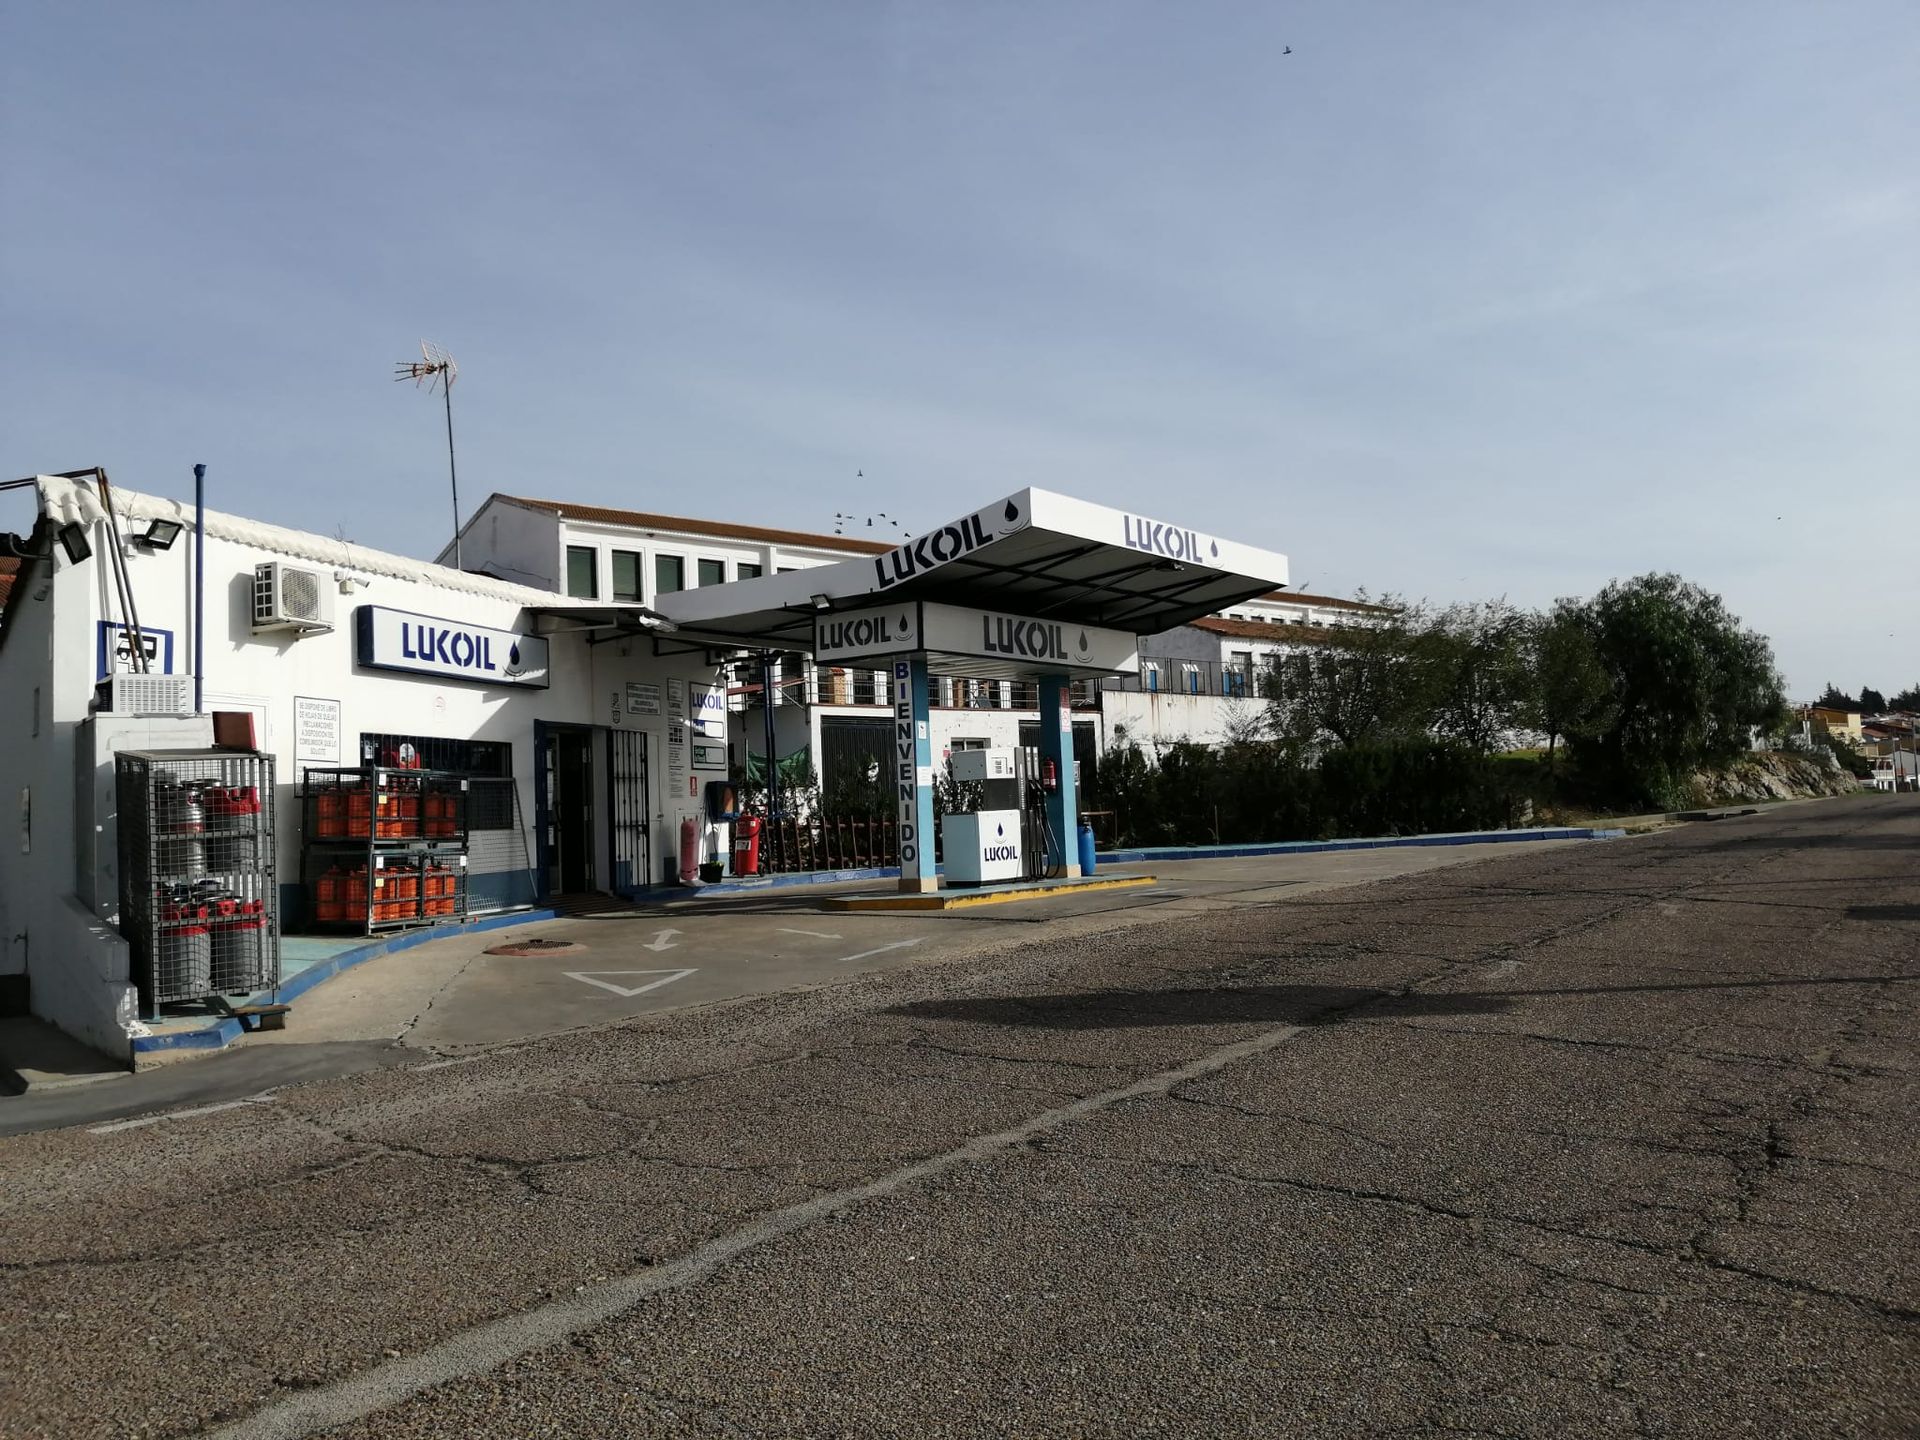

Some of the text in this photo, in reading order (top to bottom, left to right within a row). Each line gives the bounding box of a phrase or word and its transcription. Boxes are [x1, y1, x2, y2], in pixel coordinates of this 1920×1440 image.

[875, 513, 994, 590] LUKOIL
[1124, 514, 1203, 564] LUKOIL
[402, 622, 496, 671] LUKOIL
[819, 615, 891, 650] LUKOIL
[982, 614, 1068, 660] LUKOIL
[692, 692, 723, 710] LUKOIL
[895, 662, 916, 862] BIENVENIDO
[984, 846, 1018, 862] LUKOIL
